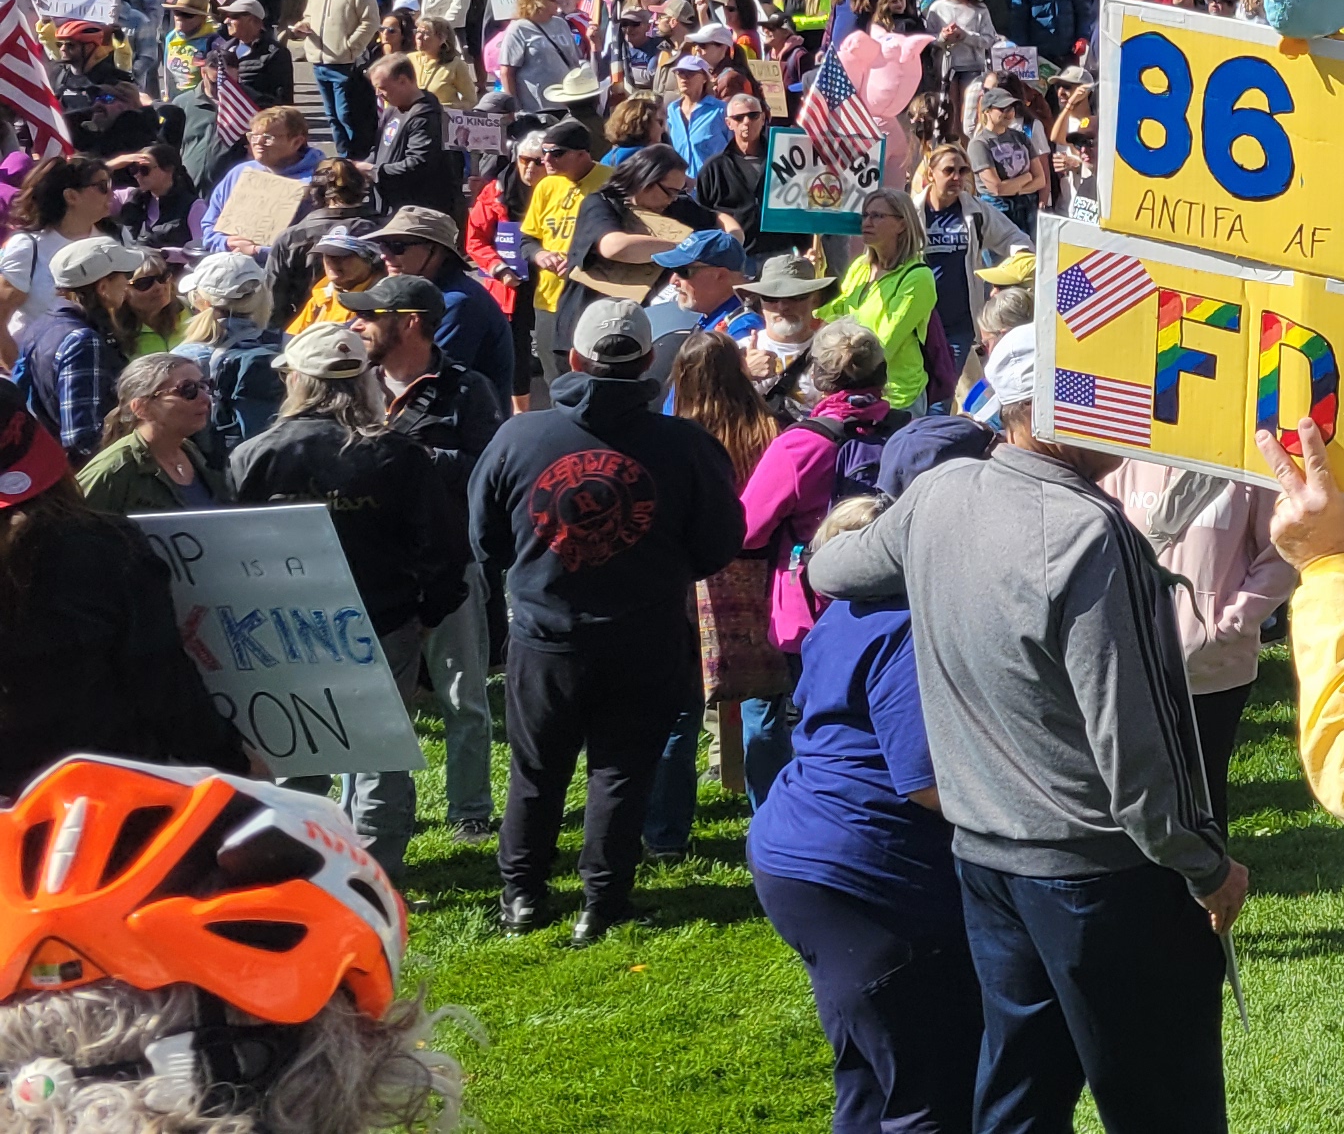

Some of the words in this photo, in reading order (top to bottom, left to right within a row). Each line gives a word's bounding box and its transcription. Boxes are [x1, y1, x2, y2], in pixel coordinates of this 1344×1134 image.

[449, 116, 463, 125] NO
[466, 117, 500, 128] KINGS
[1115, 30, 1296, 202] 86
[771, 145, 806, 185] NO
[1135, 189, 1248, 243] ANTIFA
[1283, 223, 1332, 258] AF
[240, 559, 263, 577] IS
[285, 556, 305, 576] A
[209, 687, 350, 758] RON
